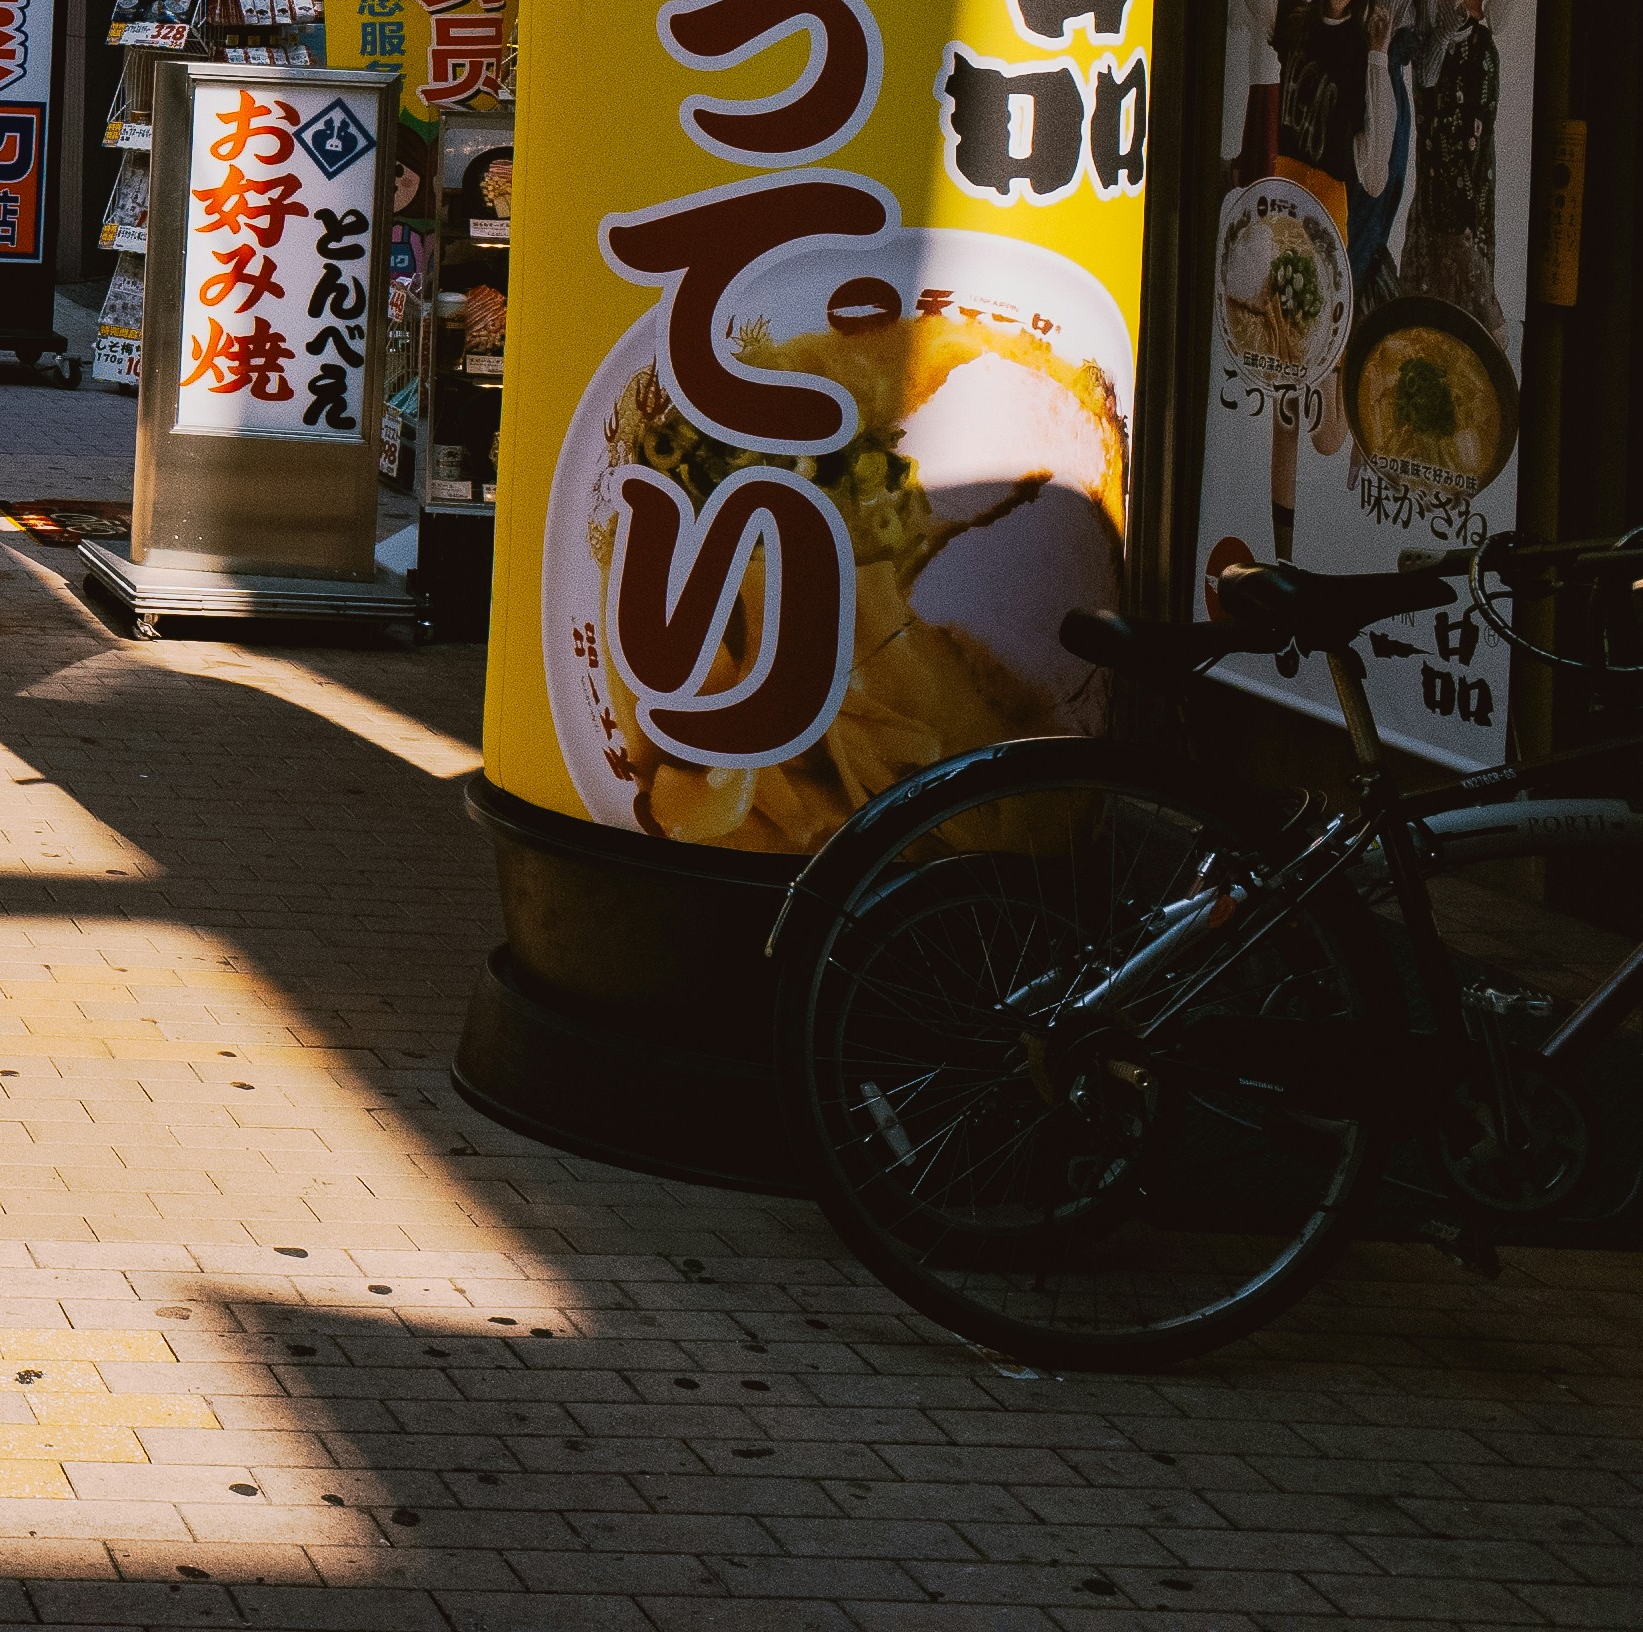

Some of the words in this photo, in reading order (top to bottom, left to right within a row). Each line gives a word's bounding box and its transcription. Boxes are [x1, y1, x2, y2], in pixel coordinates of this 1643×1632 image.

[150, 24, 186, 41] 328
[179, 90, 309, 403] お好み焼
[303, 209, 369, 430] とんべえ
[1242, 350, 1308, 378] 伝統の深みとコク
[1220, 368, 1324, 433] こってり
[1370, 454, 1478, 493] 4つの薬味で好みの味
[1361, 474, 1488, 546] 味がさね
